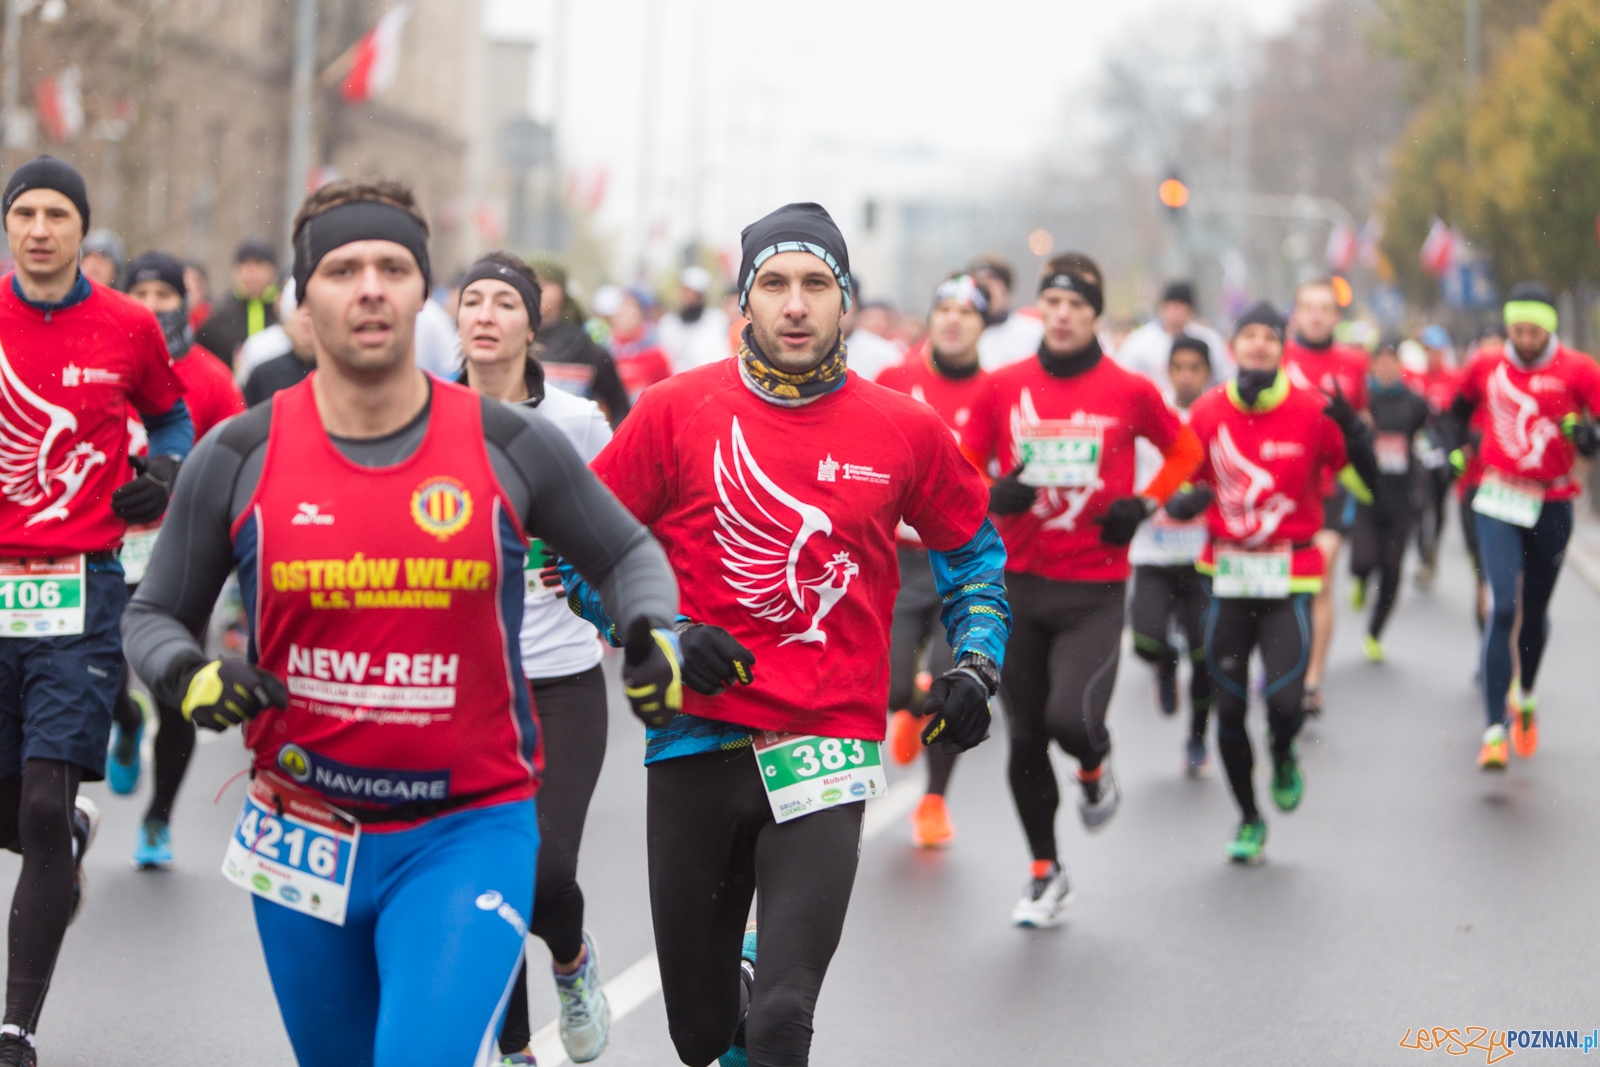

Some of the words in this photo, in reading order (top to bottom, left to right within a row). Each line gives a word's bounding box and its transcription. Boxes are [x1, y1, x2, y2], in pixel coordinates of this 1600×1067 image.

[271, 553, 399, 591] OSTRÓW
[405, 557, 491, 590] WLKP.
[0, 580, 62, 609] 106
[310, 591, 349, 609] K.S.
[355, 591, 451, 609] MARATON
[288, 643, 460, 685] NEW-REH
[765, 765, 777, 778] C
[792, 738, 865, 777] 383
[315, 767, 448, 800] NAVIGARE
[823, 773, 853, 786] Robert
[779, 799, 801, 811] GRUPA
[781, 804, 807, 818] LUXMED
[240, 808, 336, 878] 4216
